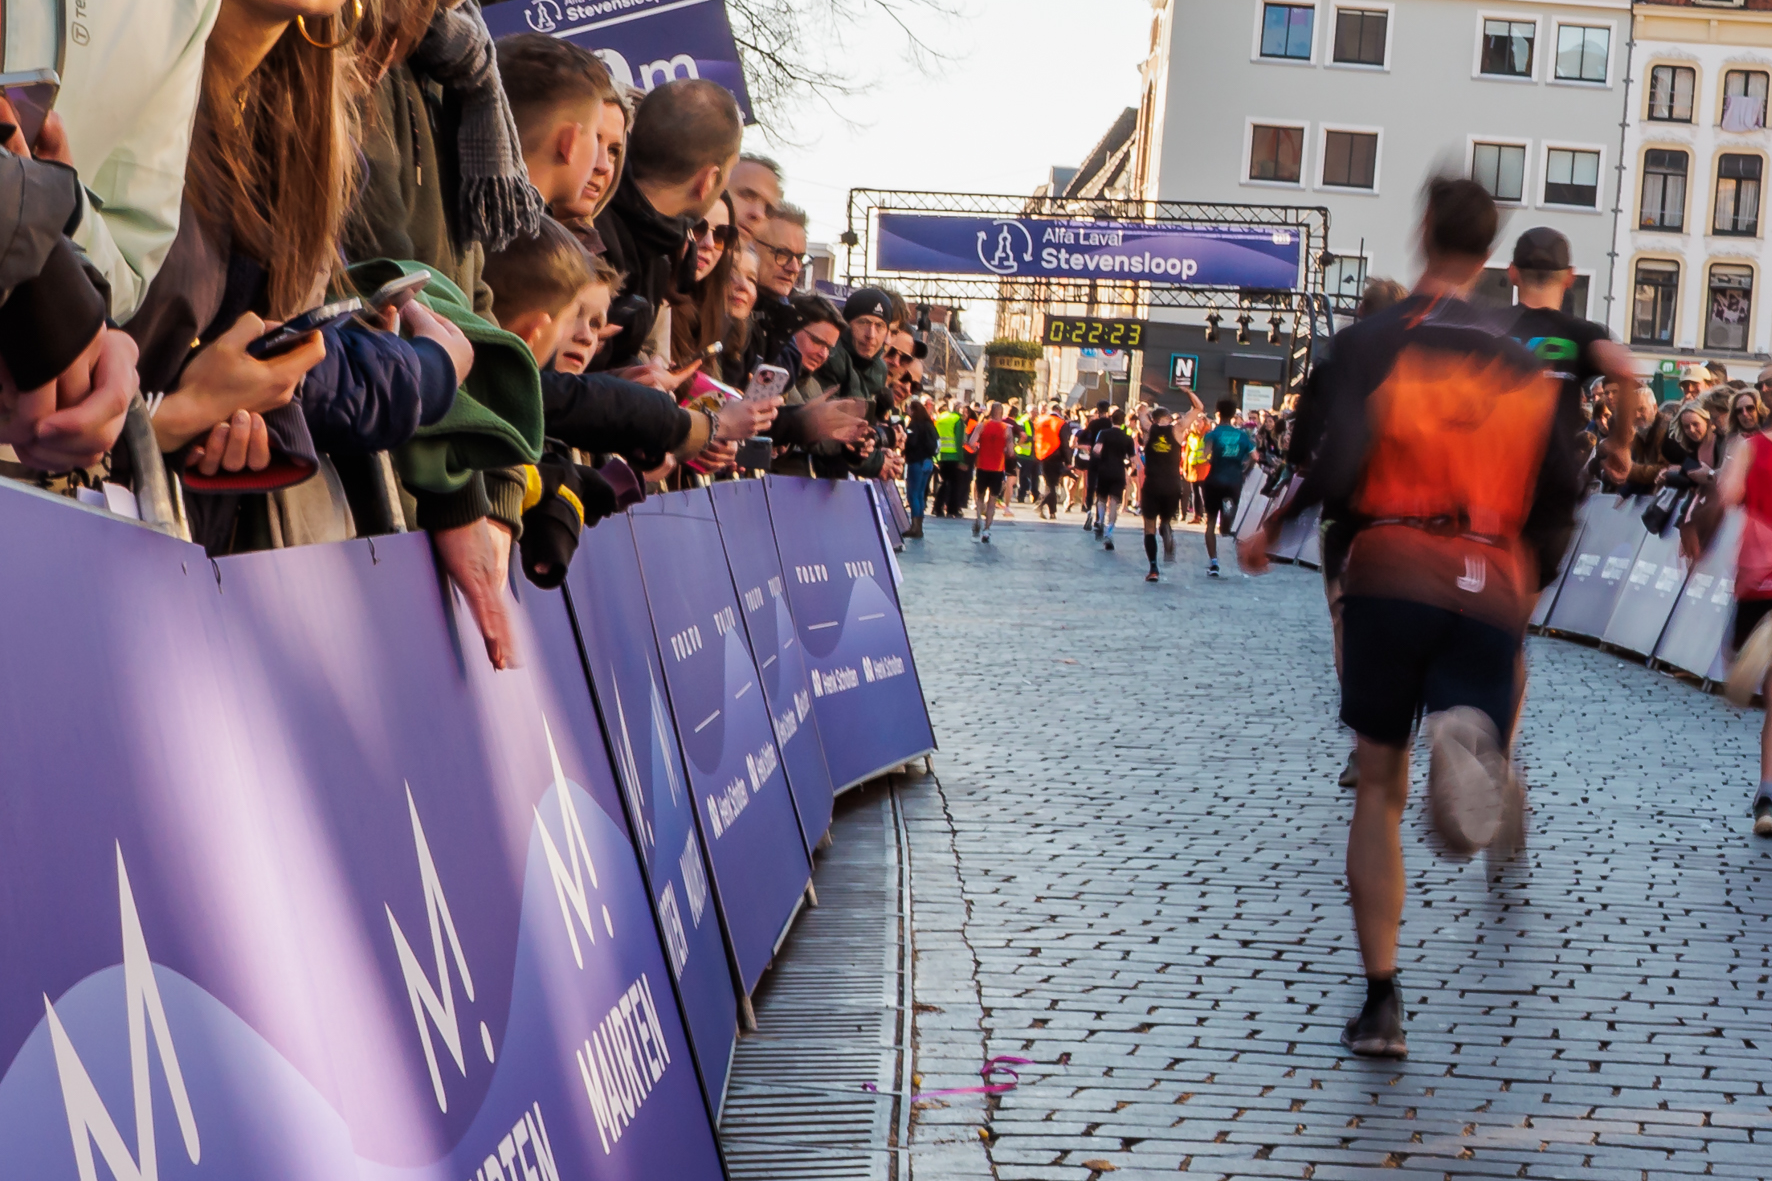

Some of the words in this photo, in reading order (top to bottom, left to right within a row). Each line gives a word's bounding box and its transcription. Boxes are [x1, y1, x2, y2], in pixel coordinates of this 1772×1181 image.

[1041, 227, 1074, 246] Alfa
[1079, 228, 1123, 247] Laval
[1040, 247, 1198, 280] Stevensloop
[1049, 320, 1142, 346] 0:22:23
[576, 971, 672, 1156] MAURTEN
